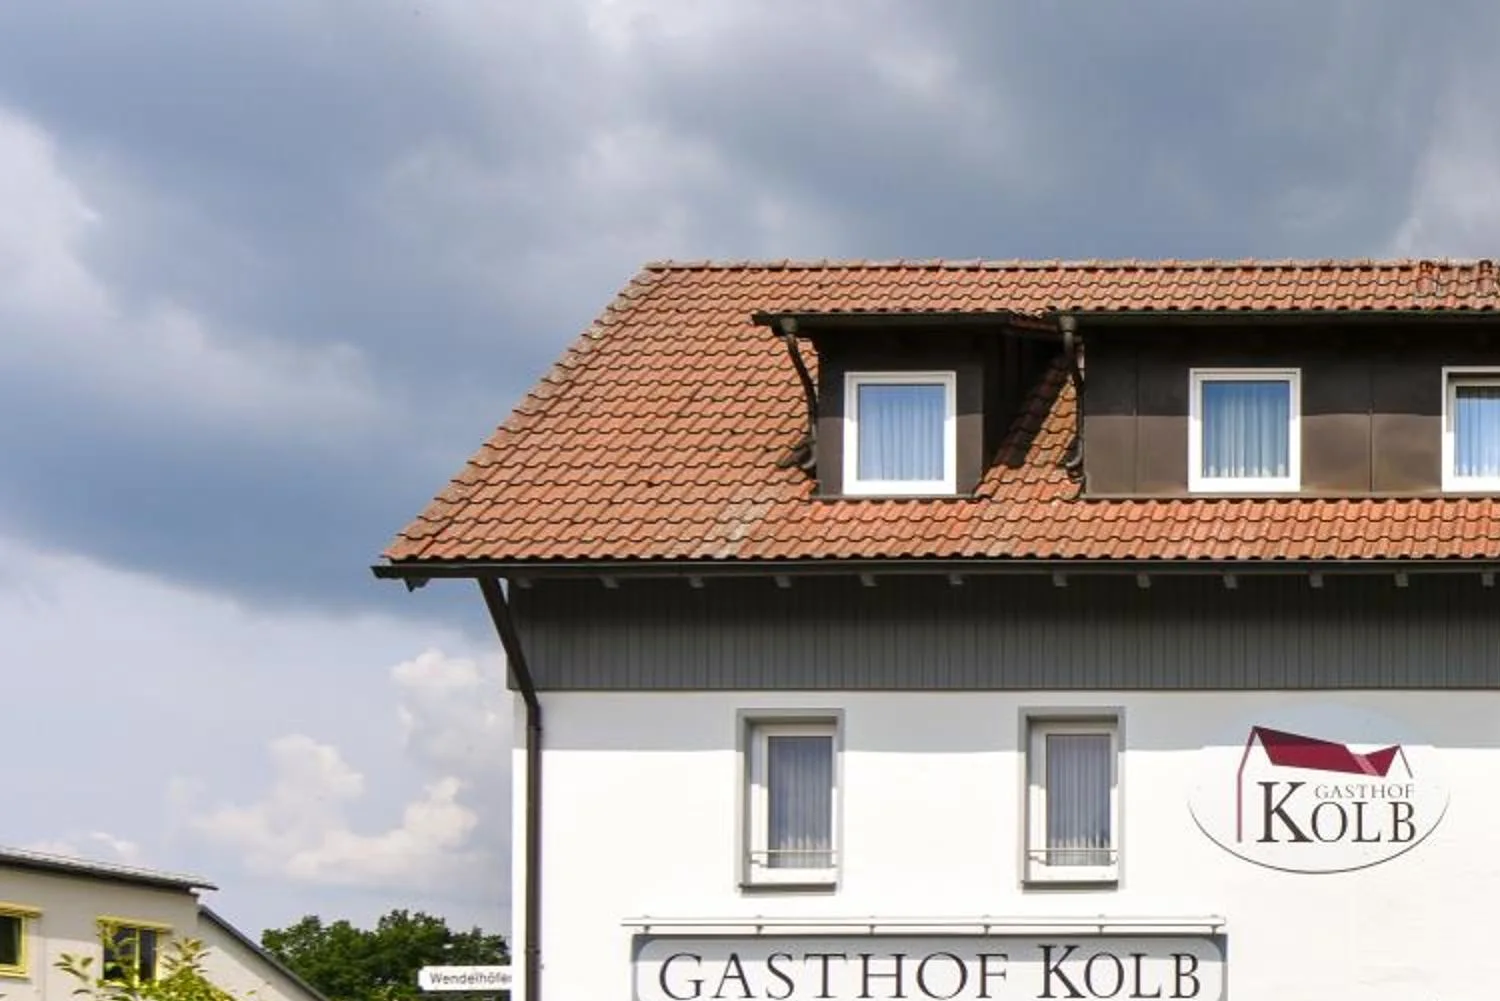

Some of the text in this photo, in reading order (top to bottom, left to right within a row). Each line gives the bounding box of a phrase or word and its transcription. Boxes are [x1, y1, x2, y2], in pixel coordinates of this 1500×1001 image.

[1256, 781, 1416, 844] KOLB
[1314, 783, 1415, 799] GASTHOF
[658, 944, 1202, 1001] GASTHOF KOLB
